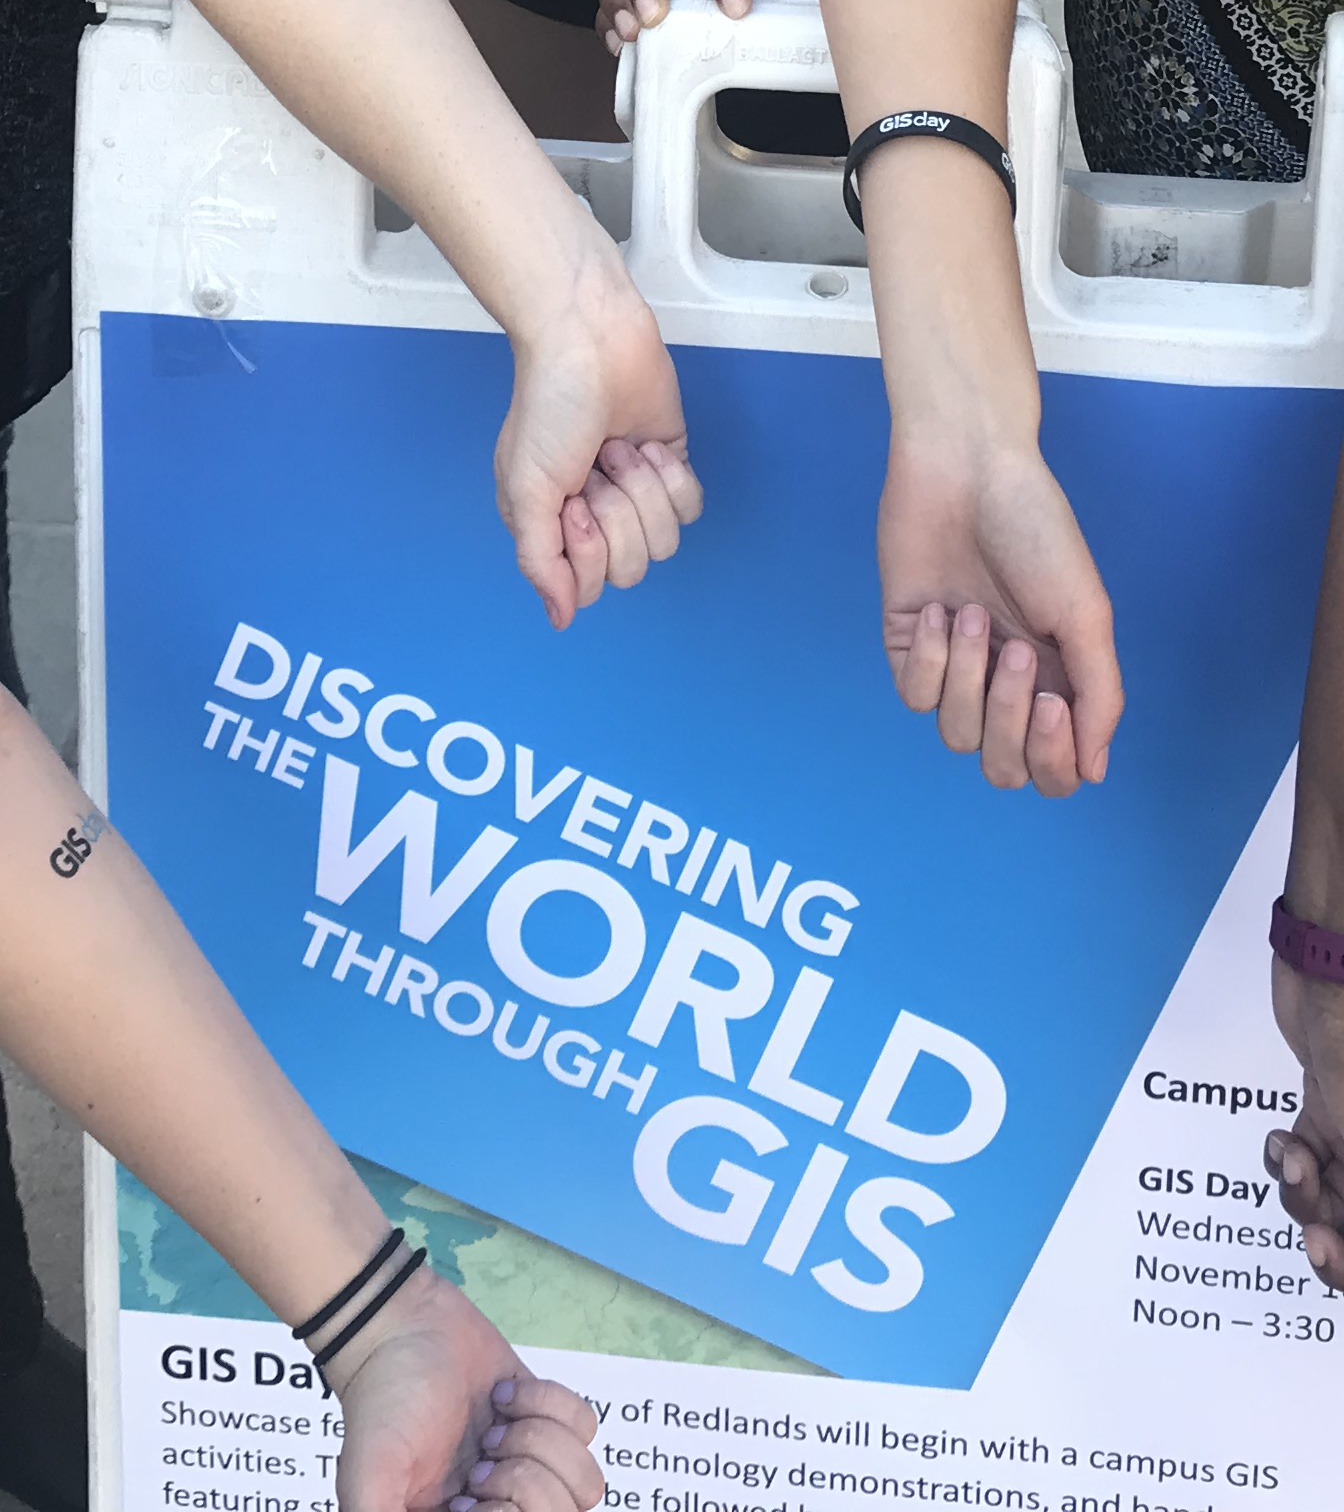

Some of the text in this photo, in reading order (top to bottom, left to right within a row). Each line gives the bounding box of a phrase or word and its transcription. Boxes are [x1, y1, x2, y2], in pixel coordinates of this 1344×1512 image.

[879, 111, 951, 133] GISday
[201, 700, 318, 790] THE
[212, 621, 860, 957] DISCOVERING
[313, 753, 1008, 1165] WORLD
[301, 909, 659, 1115] THROUGH
[1142, 1071, 1298, 1115] Campus
[632, 1094, 956, 1313] GIS
[1138, 1166, 1271, 1208] GIS Day
[1135, 1255, 1311, 1296] November
[1133, 1299, 1221, 1332] Noon
[1262, 1312, 1335, 1344] 3:30
[160, 1344, 237, 1382] GIS
[161, 1400, 311, 1437] Showcase
[162, 1445, 306, 1478] activities.
[621, 1399, 653, 1424] of
[663, 1402, 807, 1441] Redlands
[816, 1421, 870, 1447] will
[881, 1423, 968, 1460] begin
[979, 1436, 1049, 1464] with
[1061, 1447, 1077, 1466] a
[1089, 1449, 1215, 1483] campus
[1226, 1462, 1279, 1490] GIS
[603, 1443, 1049, 1512] technology demonstrations,
[604, 1482, 641, 1510] be
